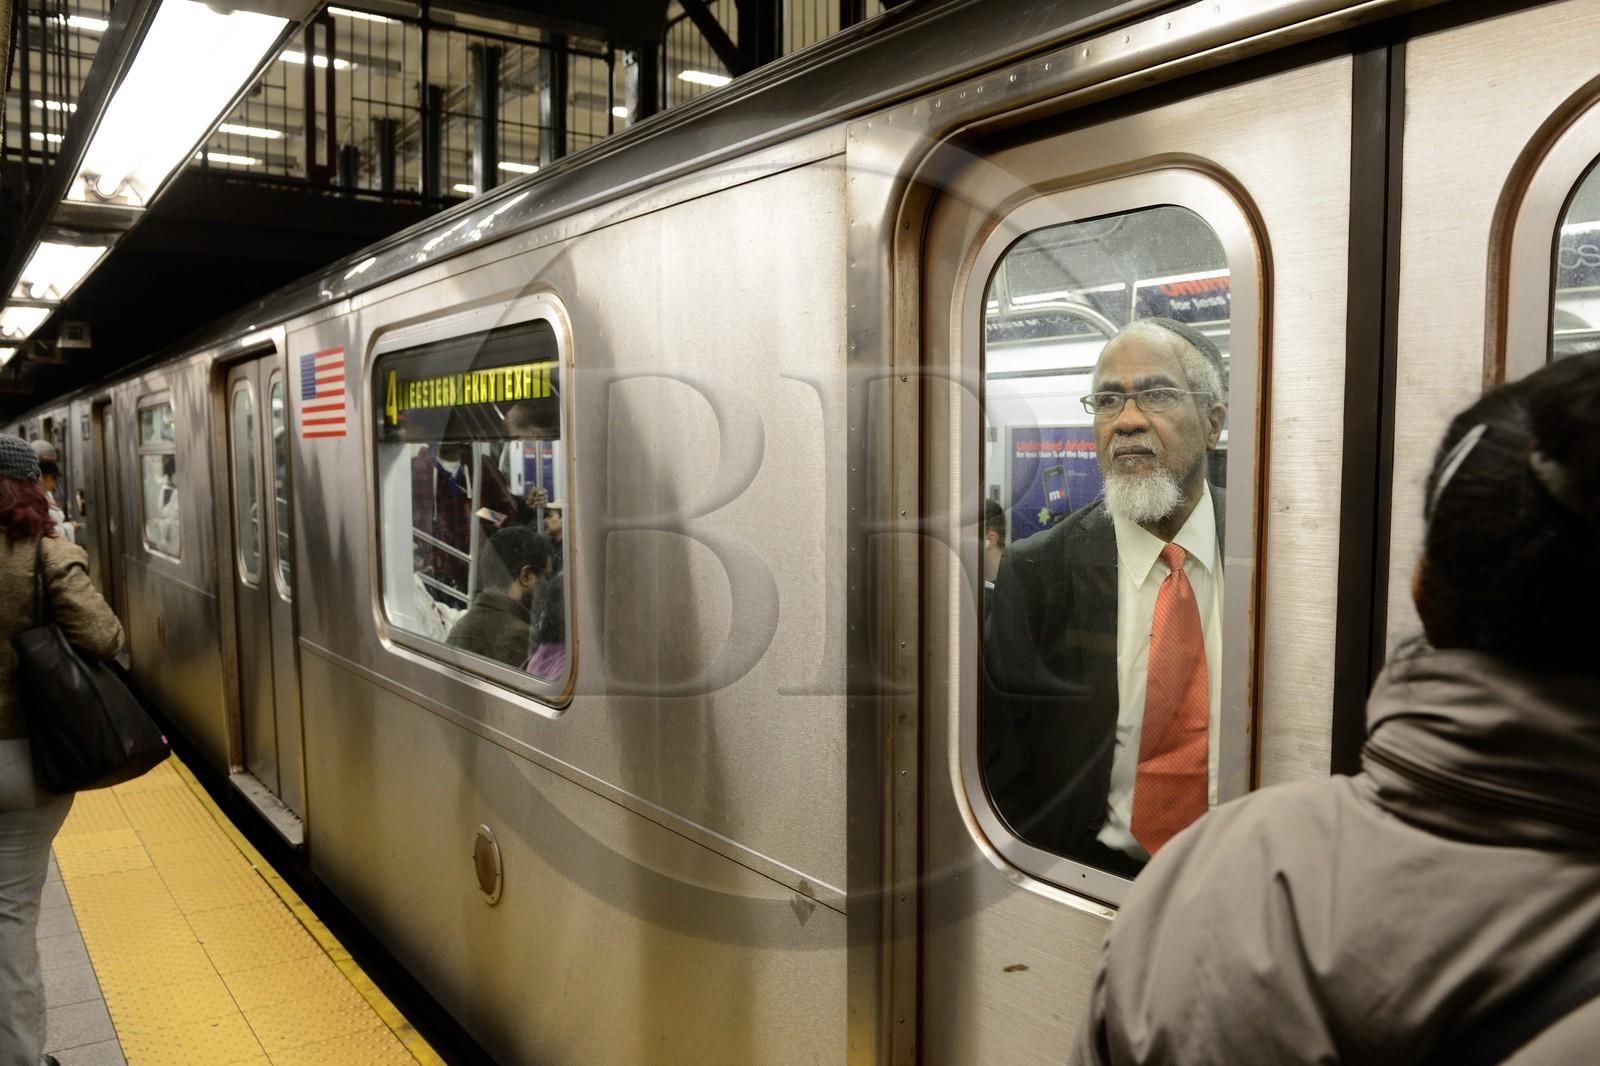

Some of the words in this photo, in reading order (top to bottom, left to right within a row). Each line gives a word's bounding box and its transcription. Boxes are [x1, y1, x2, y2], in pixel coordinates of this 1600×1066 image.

[1159, 277, 1230, 296] Unlim
[1170, 299, 1192, 311] for
[1192, 297, 1227, 311] less
[386, 370, 397, 425] 4
[505, 365, 532, 401] EXP
[1016, 441, 1061, 451] Unlimited
[1065, 440, 1096, 451] Andro
